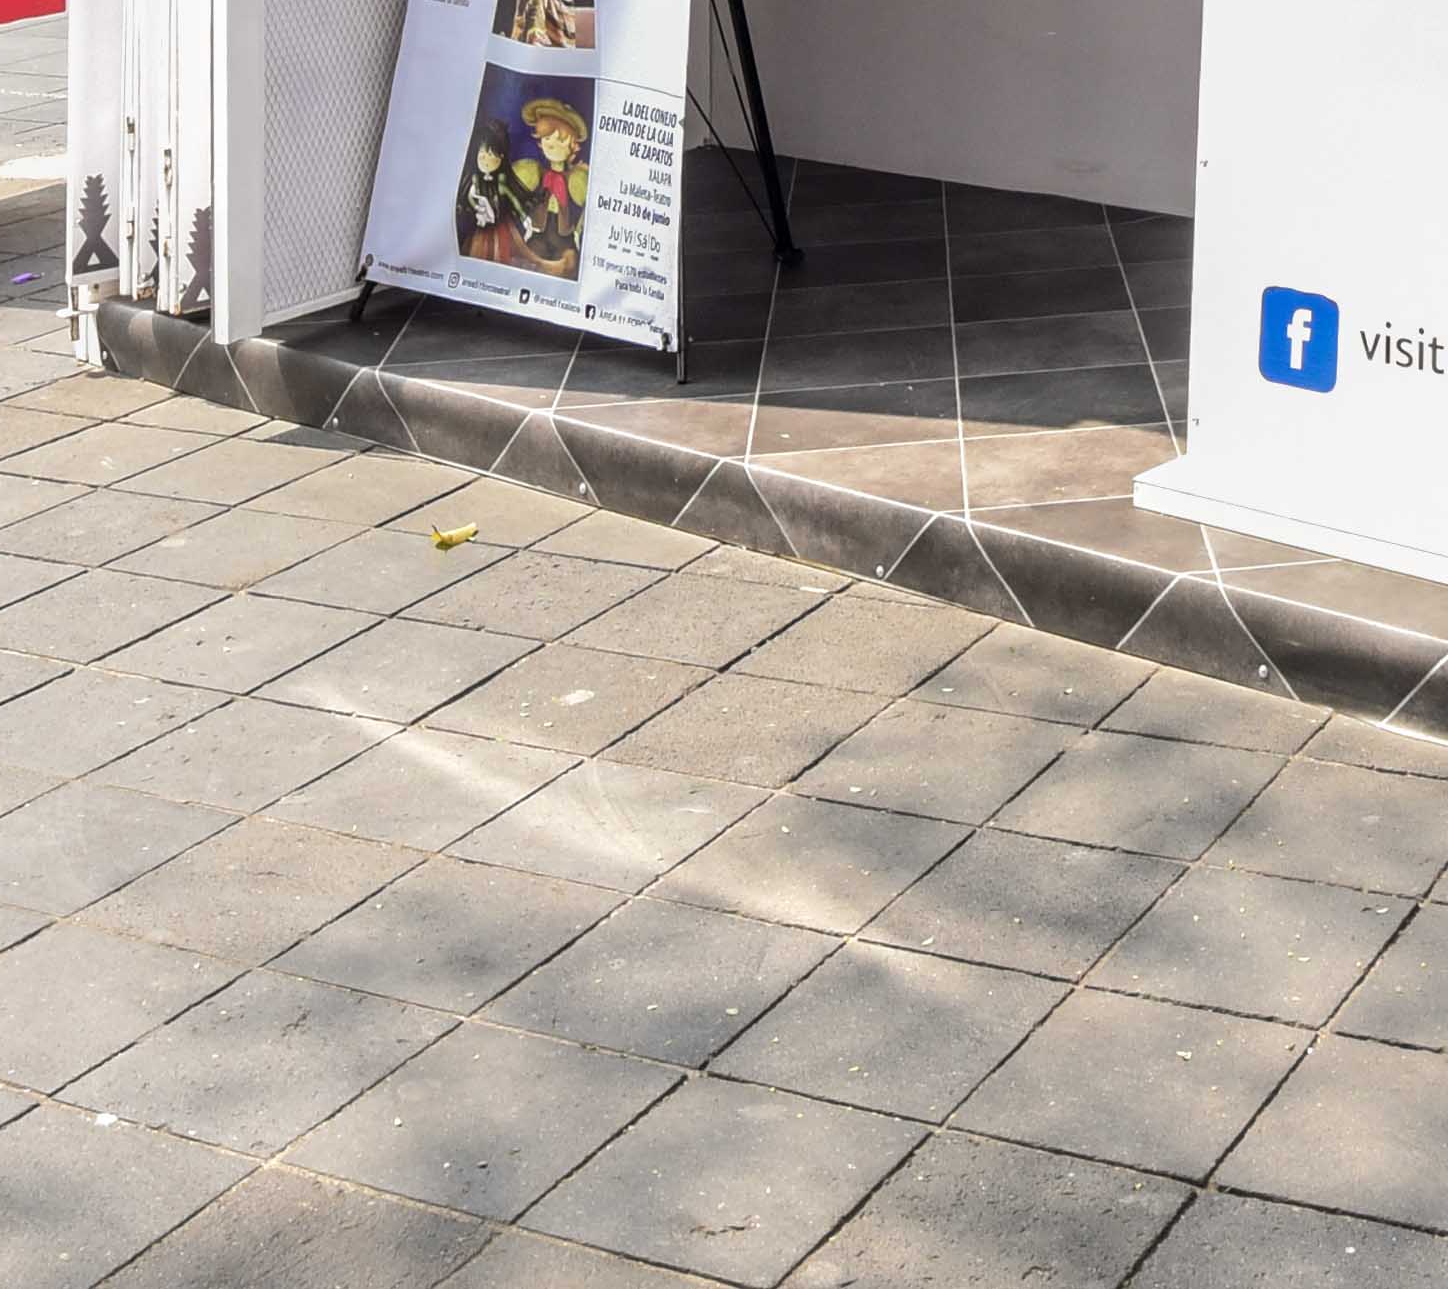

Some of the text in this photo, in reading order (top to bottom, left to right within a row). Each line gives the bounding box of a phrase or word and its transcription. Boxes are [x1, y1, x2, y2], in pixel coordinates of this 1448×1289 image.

[623, 101, 678, 129] LA DEL CONEJO
[599, 115, 674, 147] DENTRO DE LA CAJA
[630, 141, 673, 167] DE ZAPATOS
[619, 180, 629, 195] La
[597, 195, 670, 228] Del 27 al 30 de junio
